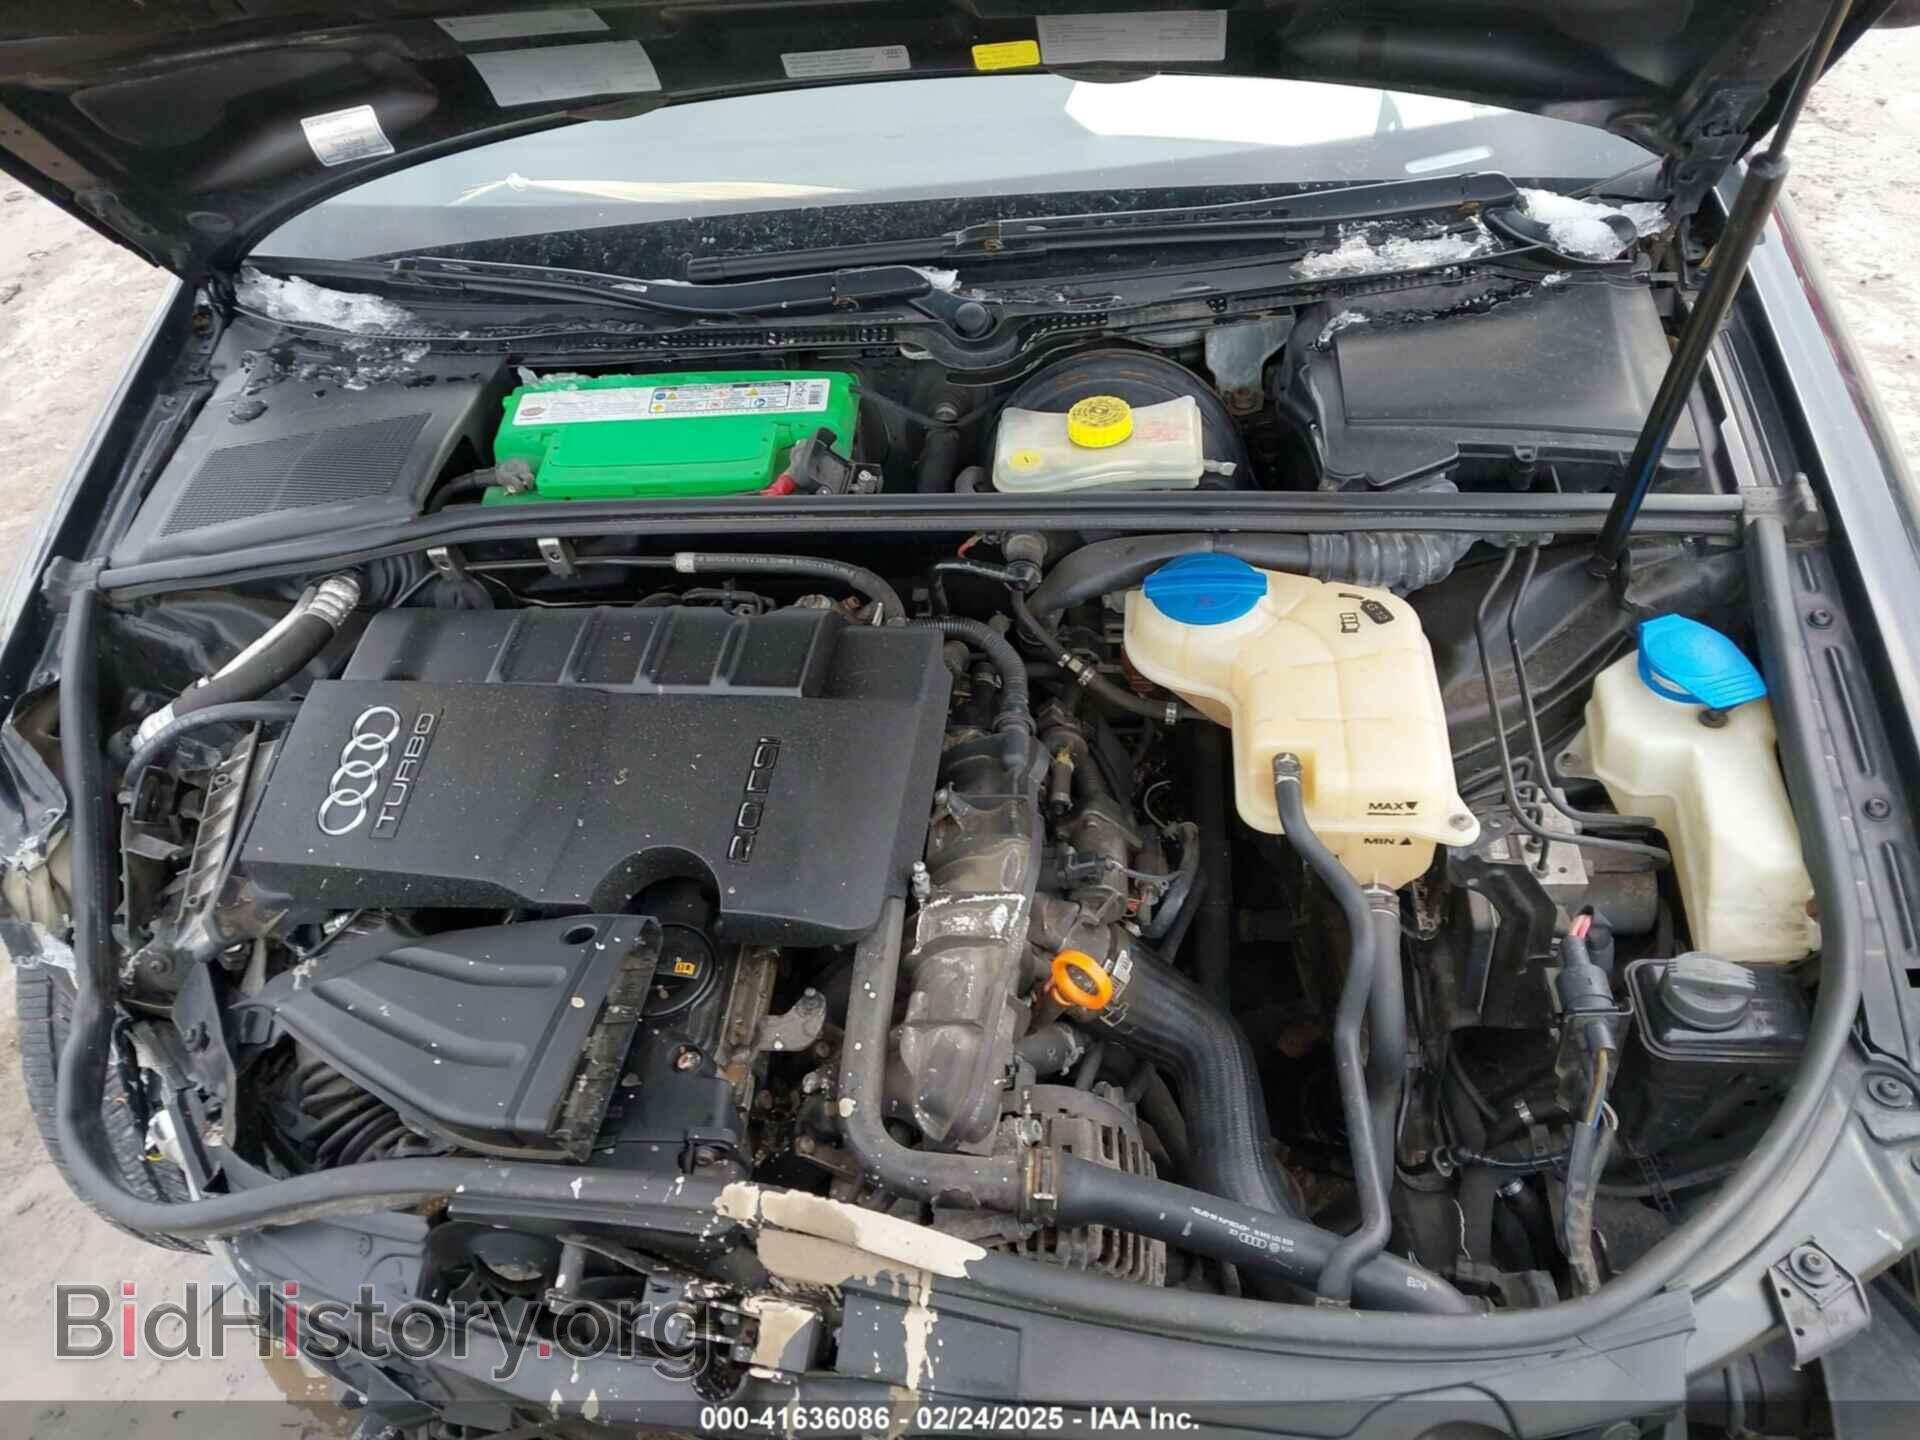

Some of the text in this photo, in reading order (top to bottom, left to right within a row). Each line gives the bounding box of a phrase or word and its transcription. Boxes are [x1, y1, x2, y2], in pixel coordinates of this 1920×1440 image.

[375, 713, 435, 829] TURBO
[1368, 802, 1404, 811] MAX
[1363, 837, 1396, 846] MIN
